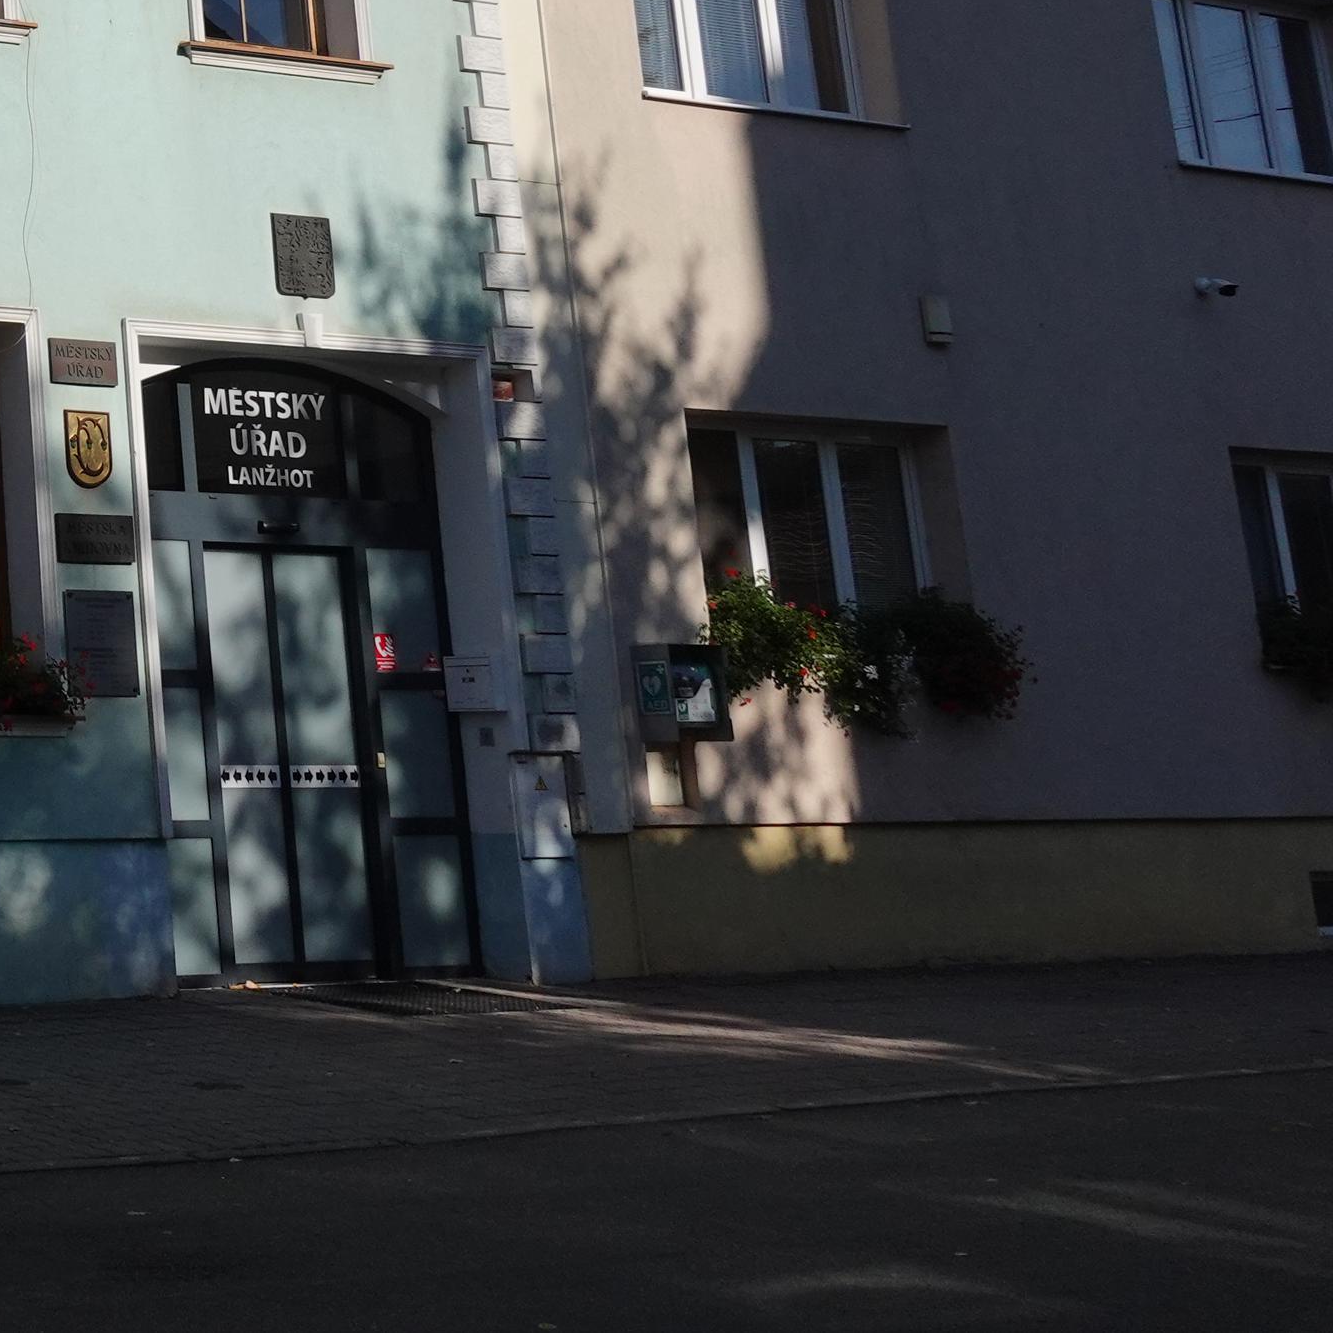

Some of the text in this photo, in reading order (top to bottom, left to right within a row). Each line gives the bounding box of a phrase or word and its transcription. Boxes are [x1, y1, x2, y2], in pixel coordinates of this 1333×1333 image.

[203, 386, 326, 421] MĚSTSKÝ
[229, 422, 307, 459] ÚŘAD
[227, 463, 314, 488] LANŽHOT
